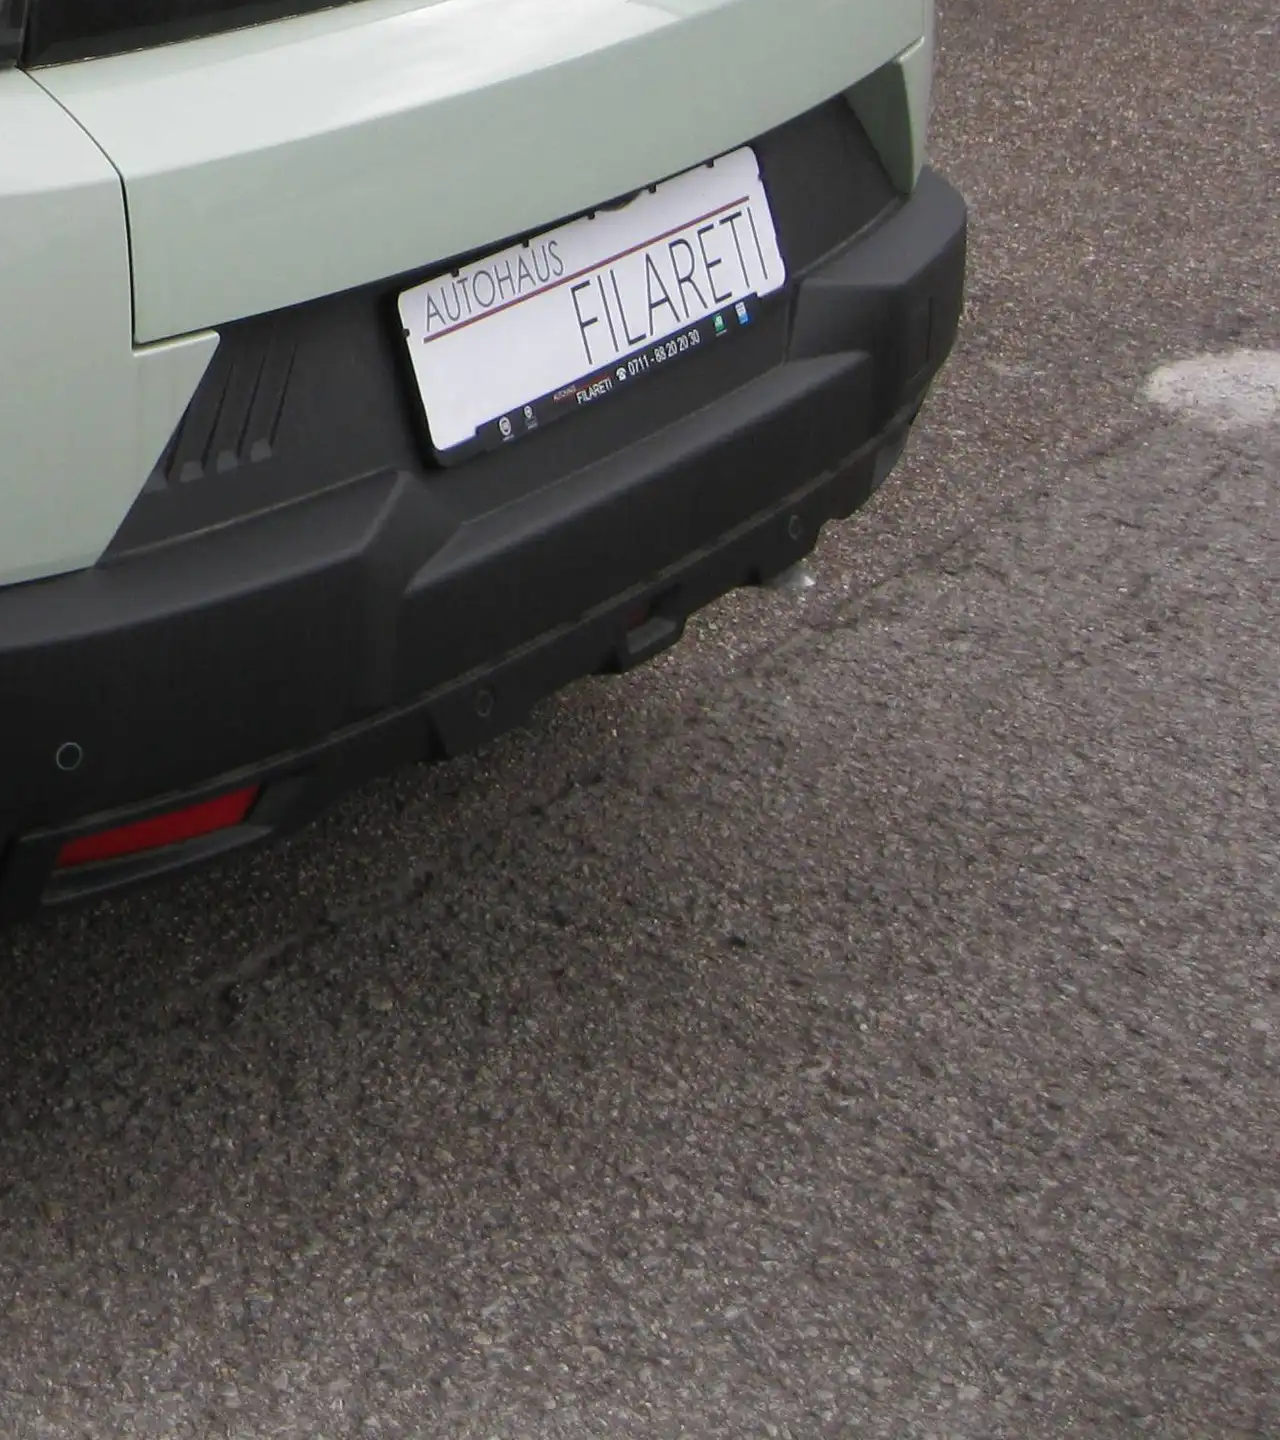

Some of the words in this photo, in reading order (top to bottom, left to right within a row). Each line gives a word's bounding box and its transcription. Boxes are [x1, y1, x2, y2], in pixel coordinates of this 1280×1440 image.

[424, 240, 565, 331] AUTOHAUS
[571, 207, 769, 365] FILARETI
[627, 355, 650, 376] 0711
[665, 341, 679, 358] 20
[677, 335, 690, 352] 20
[689, 328, 702, 346] 30
[576, 378, 613, 405] FILARETI
